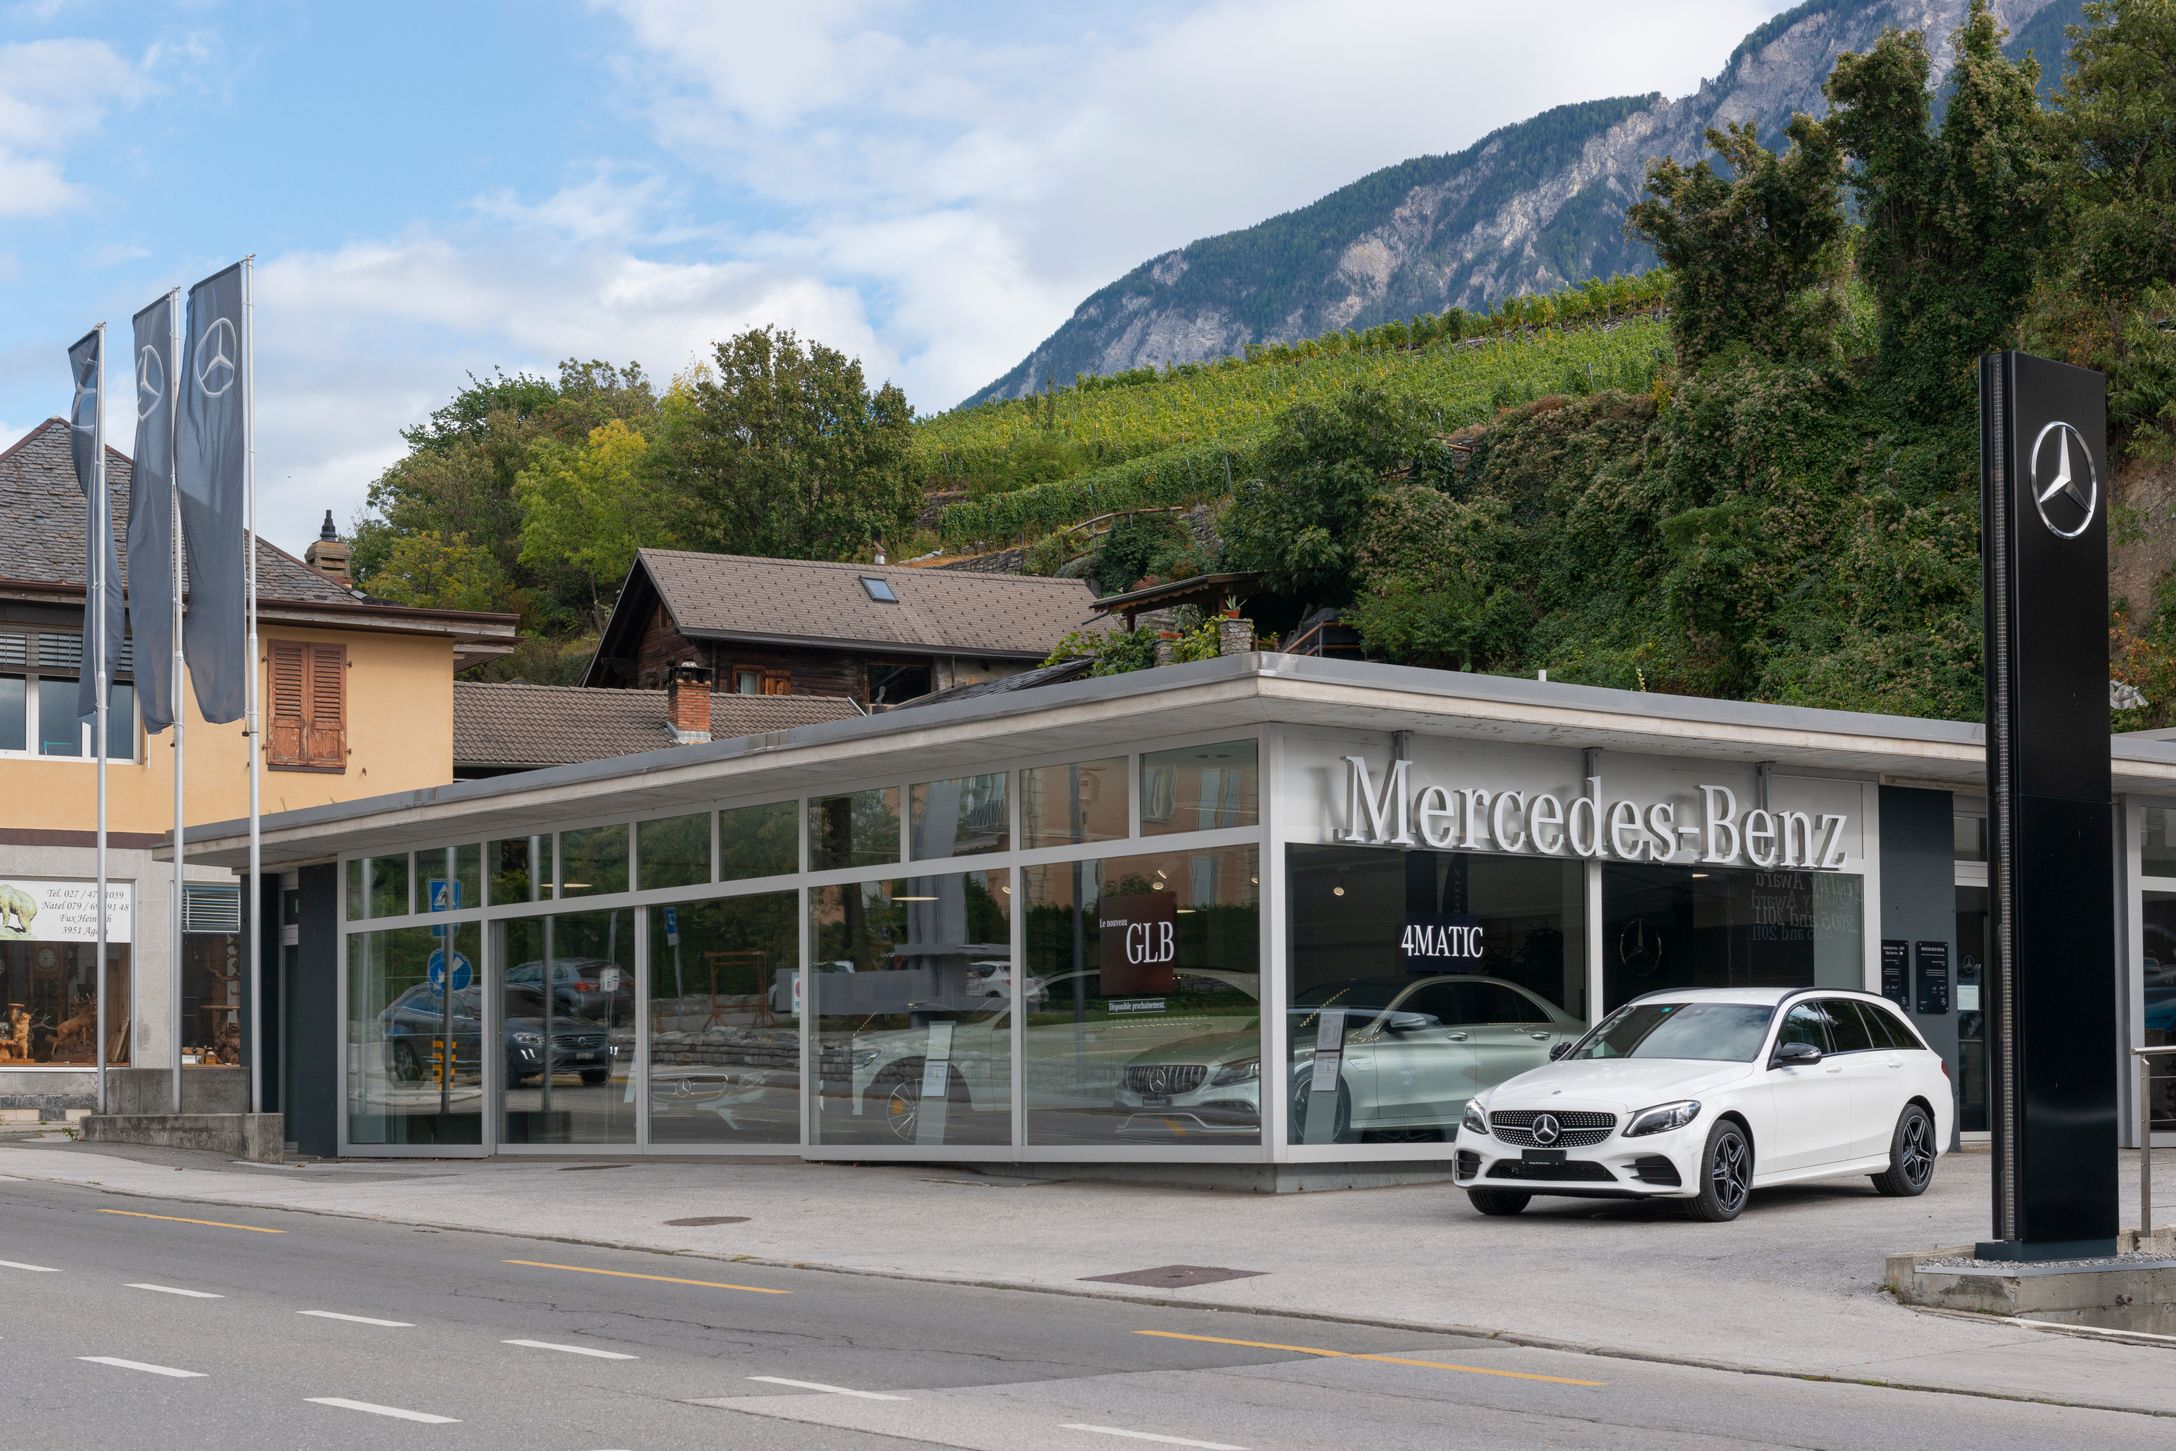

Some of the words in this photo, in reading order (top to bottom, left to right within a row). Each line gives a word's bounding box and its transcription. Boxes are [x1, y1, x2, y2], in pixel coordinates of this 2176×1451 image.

[1340, 755, 1848, 869] Mercedes-Benz
[64, 890, 79, 898] 027
[41, 901, 66, 910] Natel
[67, 902, 82, 910] 079
[78, 914, 112, 923] Heinh
[1099, 919, 1106, 928] Le
[1107, 919, 1128, 928] nouveau
[63, 926, 82, 935] 3951
[83, 926, 108, 937] Aga
[1126, 921, 1174, 964] GLB
[1401, 924, 1483, 958] 4MATIC
[1108, 1001, 1131, 1012] Disponible
